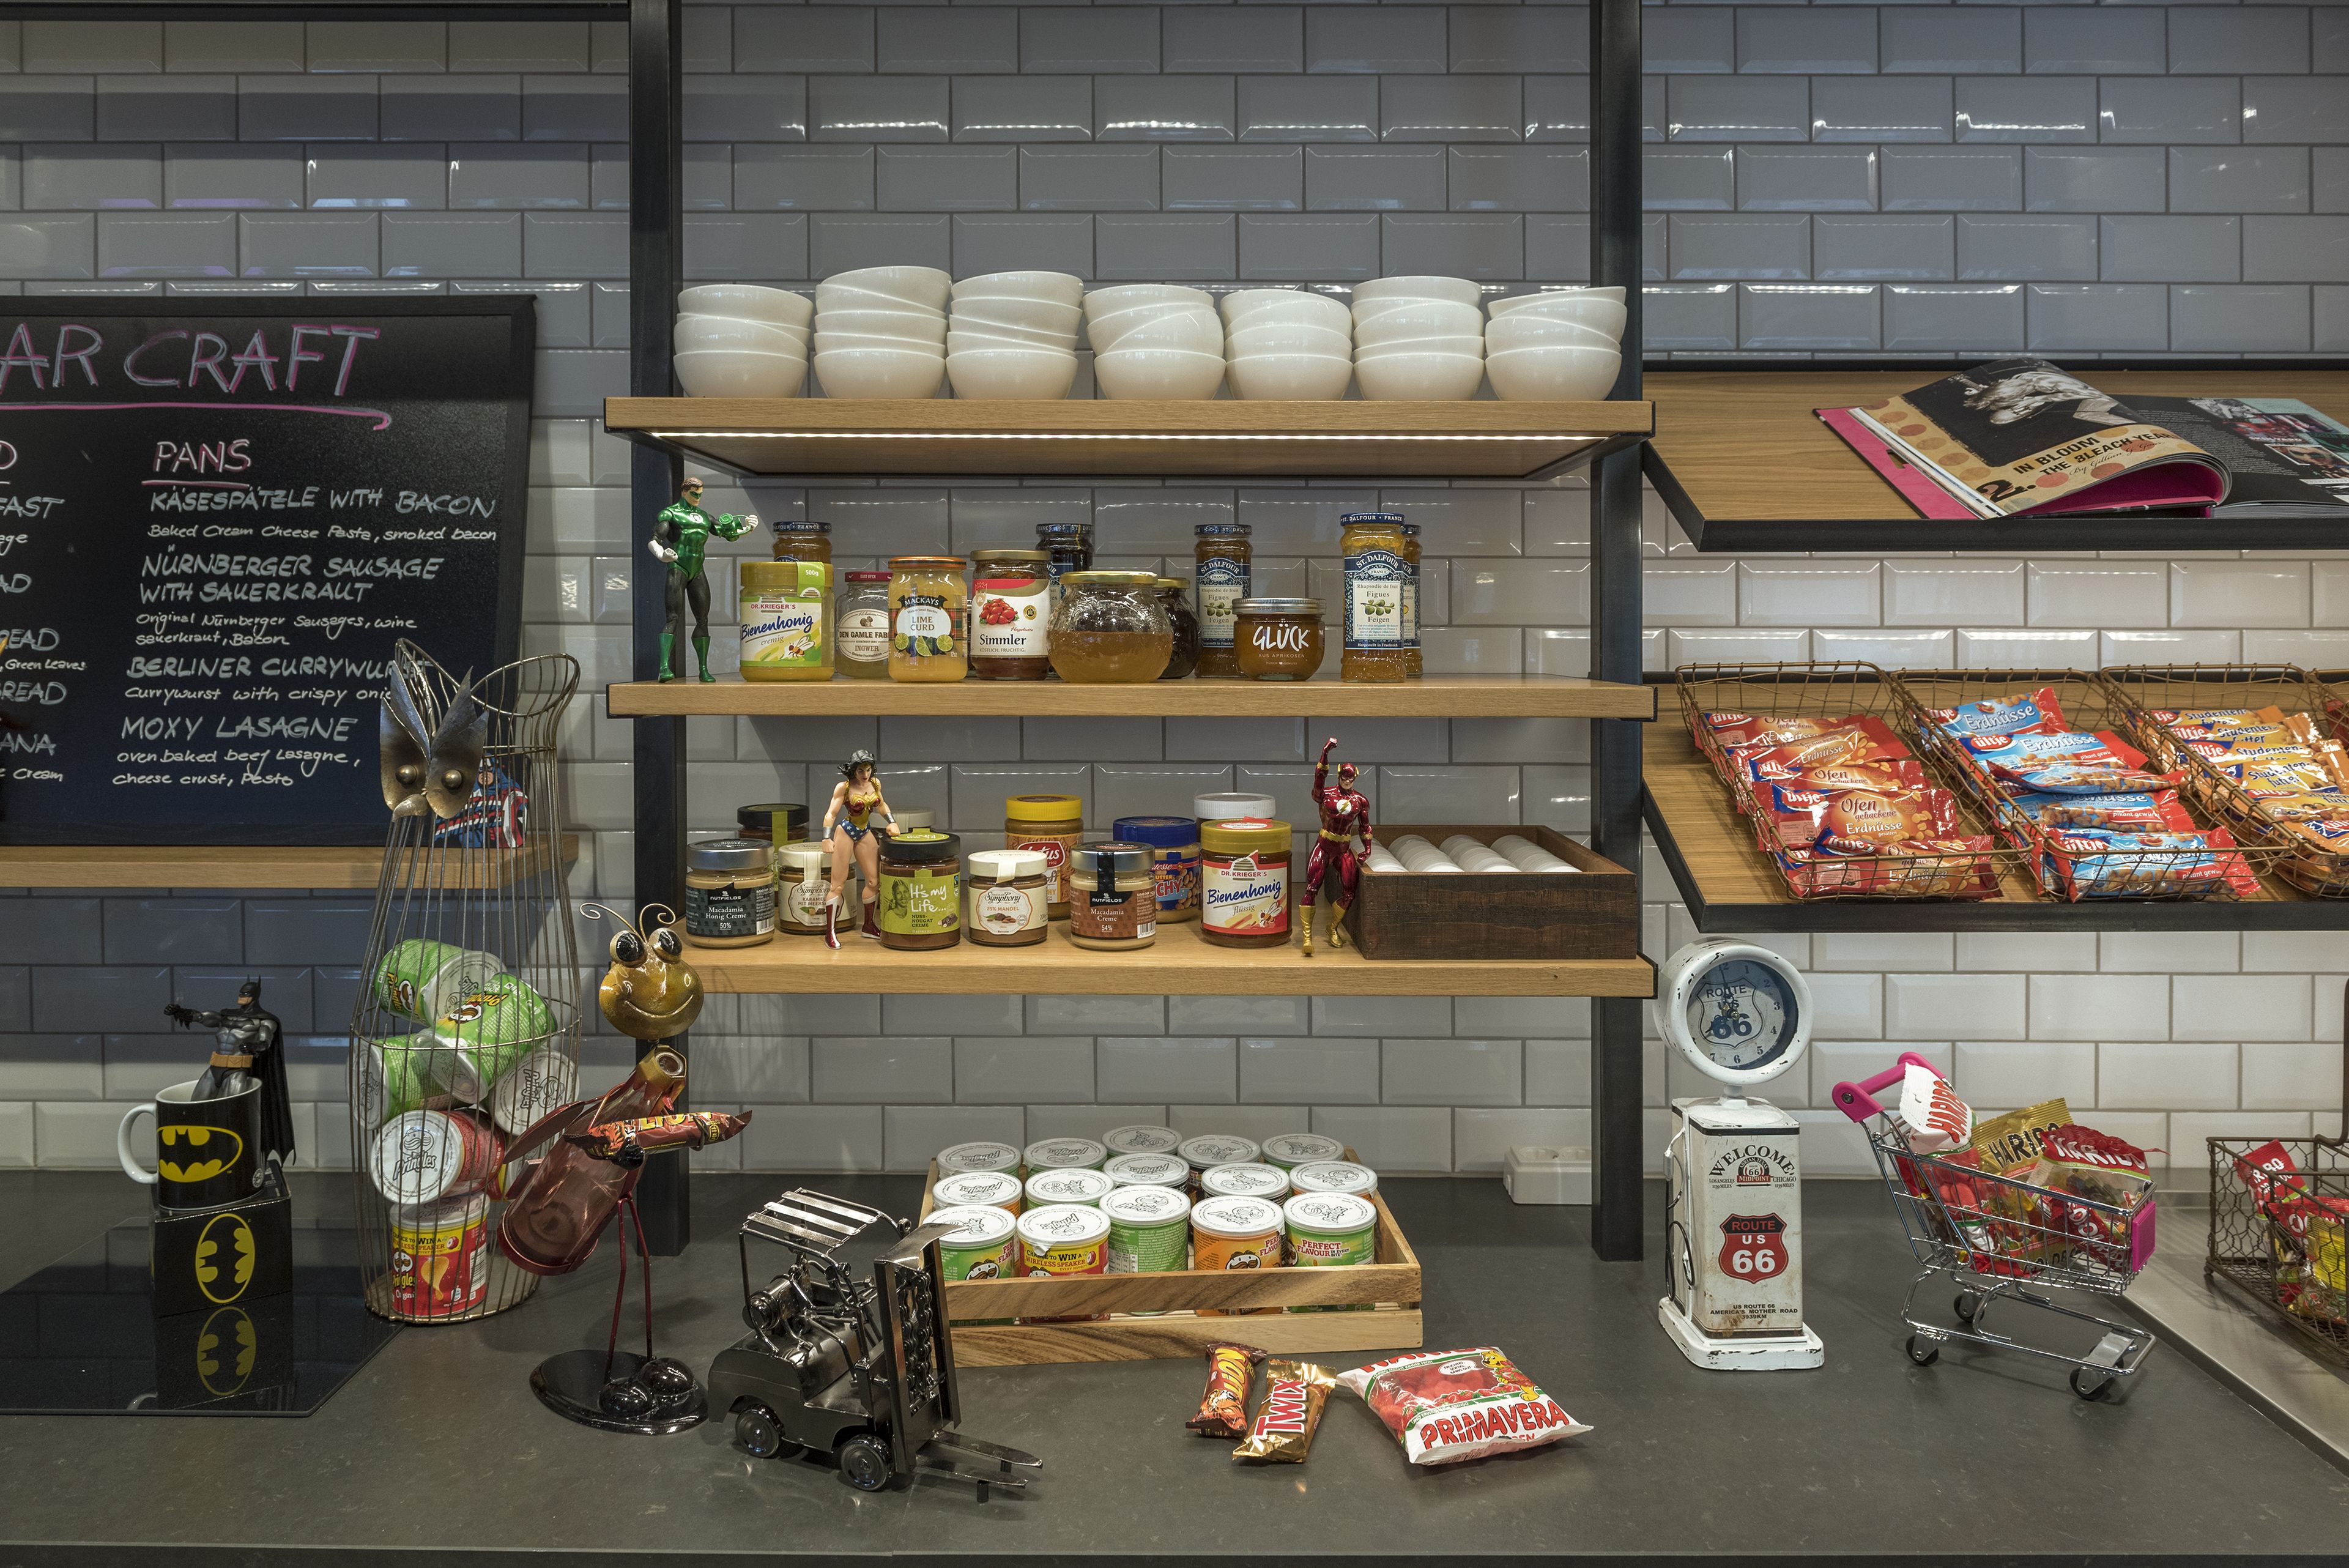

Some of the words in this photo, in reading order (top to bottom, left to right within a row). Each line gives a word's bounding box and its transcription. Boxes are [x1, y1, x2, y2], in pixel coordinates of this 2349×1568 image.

[0, 322, 104, 395] AR
[124, 324, 381, 396] CRAFT
[153, 439, 251, 474] PANS
[2013, 463, 2036, 475] IN
[2034, 436, 2101, 466] BLOOM
[2039, 461, 2073, 475] THE
[2074, 437, 2132, 463] BLEACH
[150, 485, 321, 513] KÄSESPÄTZLE
[330, 488, 383, 510] WITH
[395, 491, 496, 519] BACON
[147, 524, 198, 538] Baked
[202, 525, 254, 538] Cream
[261, 526, 320, 538] Cheese
[382, 527, 447, 541] smoked
[451, 528, 497, 541] bacon
[142, 544, 313, 578] NÜRNBERGER
[324, 557, 445, 580] SAUSAGE
[1209, 561, 1239, 574] DALFOUR
[1367, 554, 1399, 569] DALFOUR
[140, 582, 193, 604] WITH
[199, 582, 374, 603] SAUERKRAUT
[904, 597, 940, 606] MACKAYS
[136, 612, 196, 635] Original
[294, 615, 368, 640] Sausages,
[374, 615, 418, 629] wine
[740, 612, 814, 641] Bienenhonig
[229, 633, 291, 647] Bacon
[760, 634, 785, 646] cremig
[979, 633, 1027, 645] Simmler
[1252, 623, 1310, 652] GLÜCK
[5, 658, 42, 671] Green
[126, 656, 252, 679] BERLINER
[125, 687, 221, 706] Currywurst
[232, 686, 279, 701] with
[288, 688, 347, 707] crispy
[1713, 713, 1745, 724] ültje
[1963, 704, 2036, 730] Erdnüsse
[122, 715, 204, 741] MOXY
[216, 716, 359, 741] LASAGNE
[1973, 734, 2008, 748] ültje
[2018, 734, 2100, 752] Erdnüsse
[1800, 743, 1846, 765] Erdnüsse
[2080, 752, 2097, 761] pikant
[117, 751, 157, 764] oven
[160, 749, 218, 764] baked
[224, 749, 272, 776] beef
[12, 768, 64, 782] Cream
[180, 773, 234, 787] crust,
[240, 773, 294, 787] Pesto
[1814, 769, 1849, 780] Ofen
[1786, 790, 1821, 804] ültje
[1840, 797, 1877, 816] Ofen
[1845, 822, 1904, 834] Erdnüsse
[1828, 835, 1866, 850] ültje
[1888, 868, 1949, 882] Erdnüsse
[2181, 871, 2200, 880] pikant
[910, 883, 929, 899] It's
[930, 885, 947, 901] my
[984, 891, 1022, 904] Symphony
[1206, 879, 1282, 905] Bienenhonig
[1233, 904, 1256, 916] flüssig
[1706, 984, 1747, 998] ROUTE
[1773, 1001, 1781, 1011] 3
[1712, 1013, 1753, 1039] 66
[1770, 1026, 1778, 1035] 4
[1757, 1046, 1764, 1055] 5
[1734, 1055, 1741, 1064] 6
[960, 1150, 1001, 1162] Pringles
[1048, 1146, 1089, 1159] Pringles
[392, 1152, 437, 1181] Pringles
[1129, 1162, 1170, 1174] Pringles
[959, 1181, 1003, 1194] Pringles
[1040, 1213, 1080, 1230] Pringles
[1732, 1219, 1776, 1231] ROUTE
[1297, 1244, 1330, 1257] FLAVOUR
[1301, 1239, 1341, 1250] PERFECT
[1025, 1255, 1056, 1267] WIRELESS
[1056, 1258, 1086, 1268] SPEAKER
[1732, 1249, 1776, 1274] 66
[1214, 1348, 1246, 1403] LION
[1254, 1378, 1308, 1438] TWIX
[1419, 1399, 1570, 1451] PRIMAVERA
